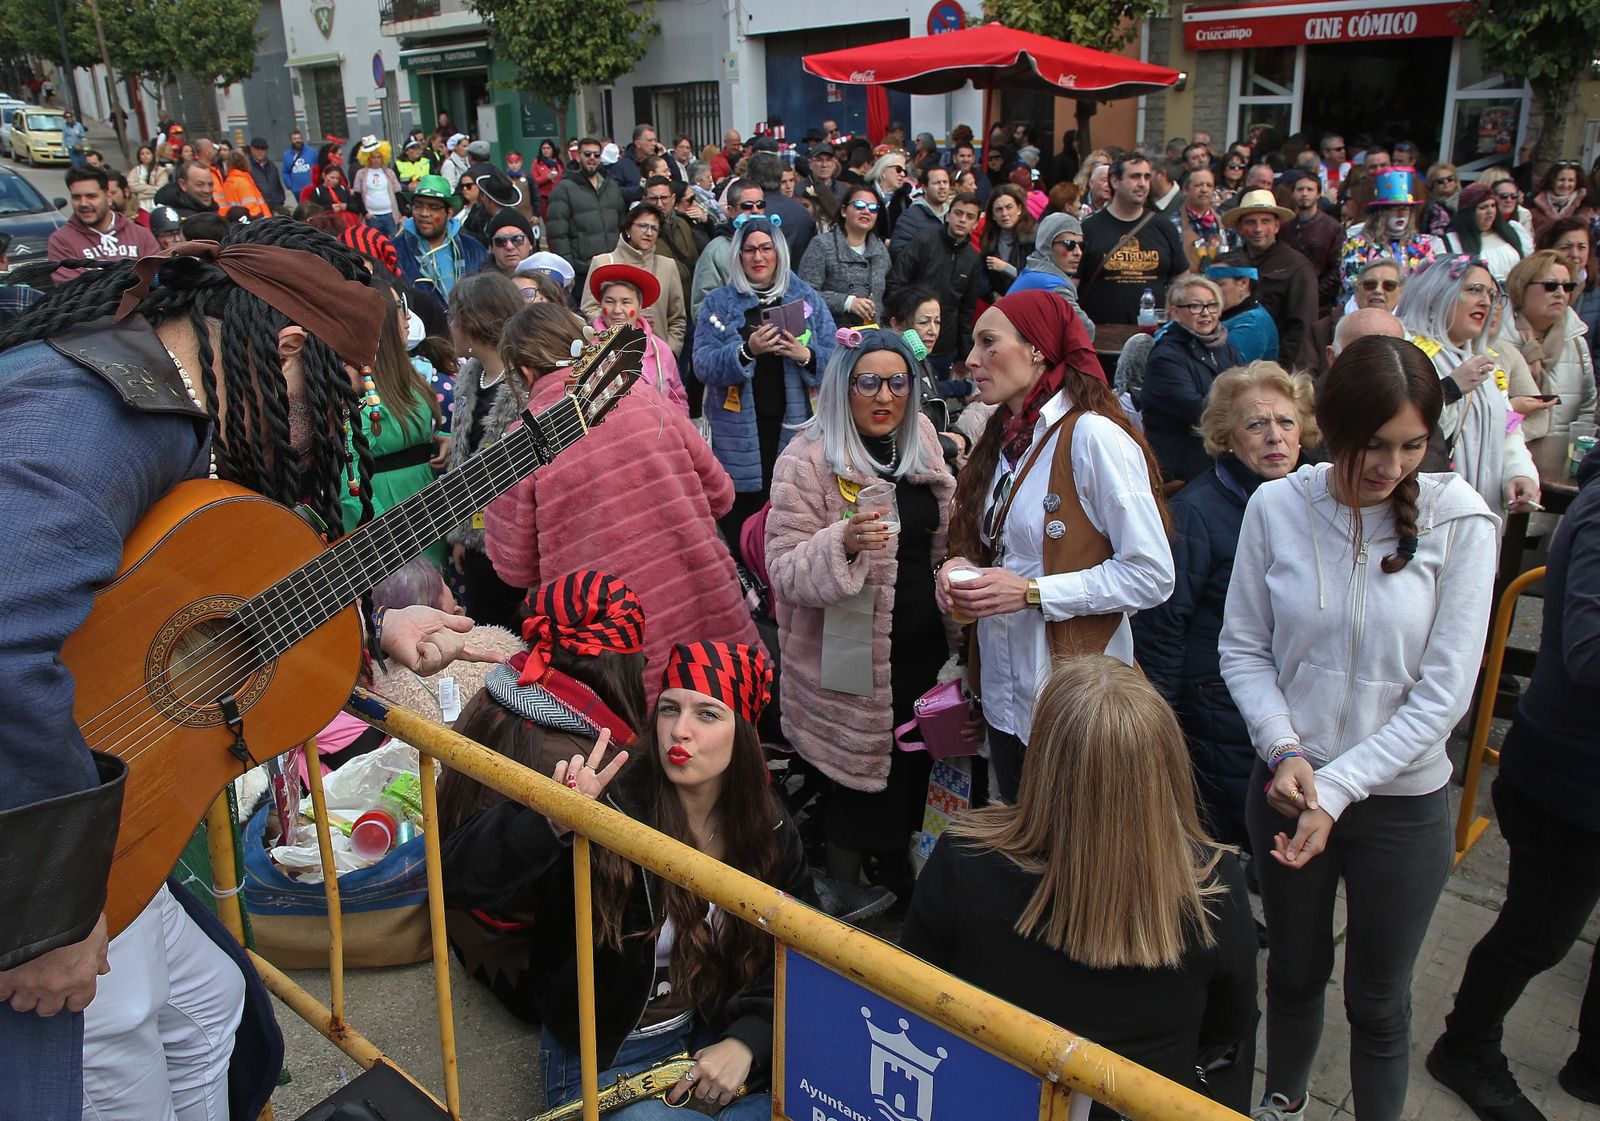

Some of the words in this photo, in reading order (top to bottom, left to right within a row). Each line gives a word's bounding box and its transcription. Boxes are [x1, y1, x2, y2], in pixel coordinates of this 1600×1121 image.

[1305, 17, 1343, 40] CINE
[1348, 11, 1418, 37] CÓMICO
[1196, 28, 1252, 41] Cruzcampo
[1104, 250, 1160, 262] OSTROMO
